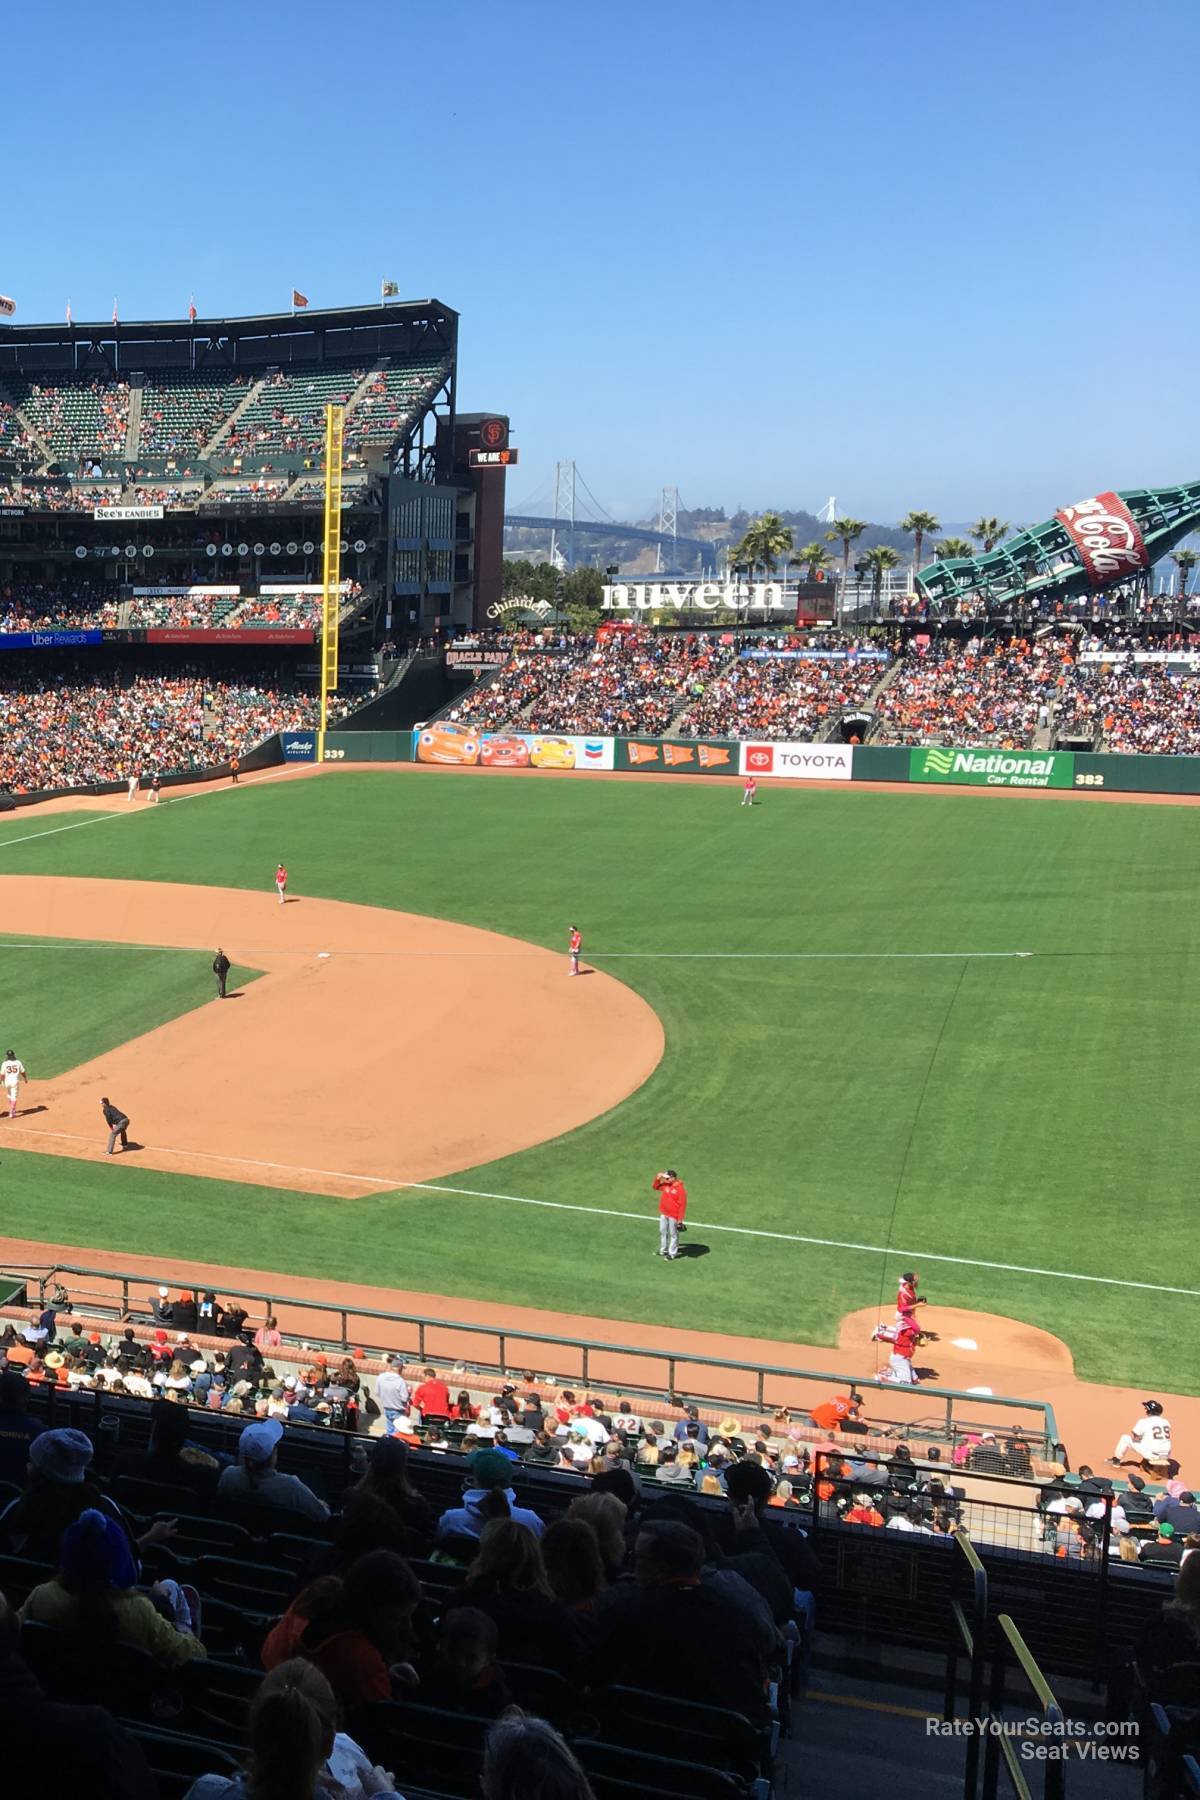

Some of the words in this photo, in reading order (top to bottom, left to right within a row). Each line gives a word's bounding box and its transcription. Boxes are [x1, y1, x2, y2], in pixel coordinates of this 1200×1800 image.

[477, 452, 488, 463] WE
[488, 452, 500, 462] ARE
[97, 508, 123, 519] See's
[125, 509, 159, 518] CANDIES
[600, 582, 785, 611] nuveen
[31, 633, 53, 645] Uber
[54, 631, 87, 645] Rewards
[324, 750, 345, 759] 339
[781, 753, 846, 769] TOYOTA
[953, 753, 1054, 776] National
[987, 774, 1005, 785] Car
[1010, 775, 1049, 786] Rental
[1075, 774, 1104, 786] 382
[6, 1065, 18, 1074] 35
[617, 1418, 636, 1431] 22
